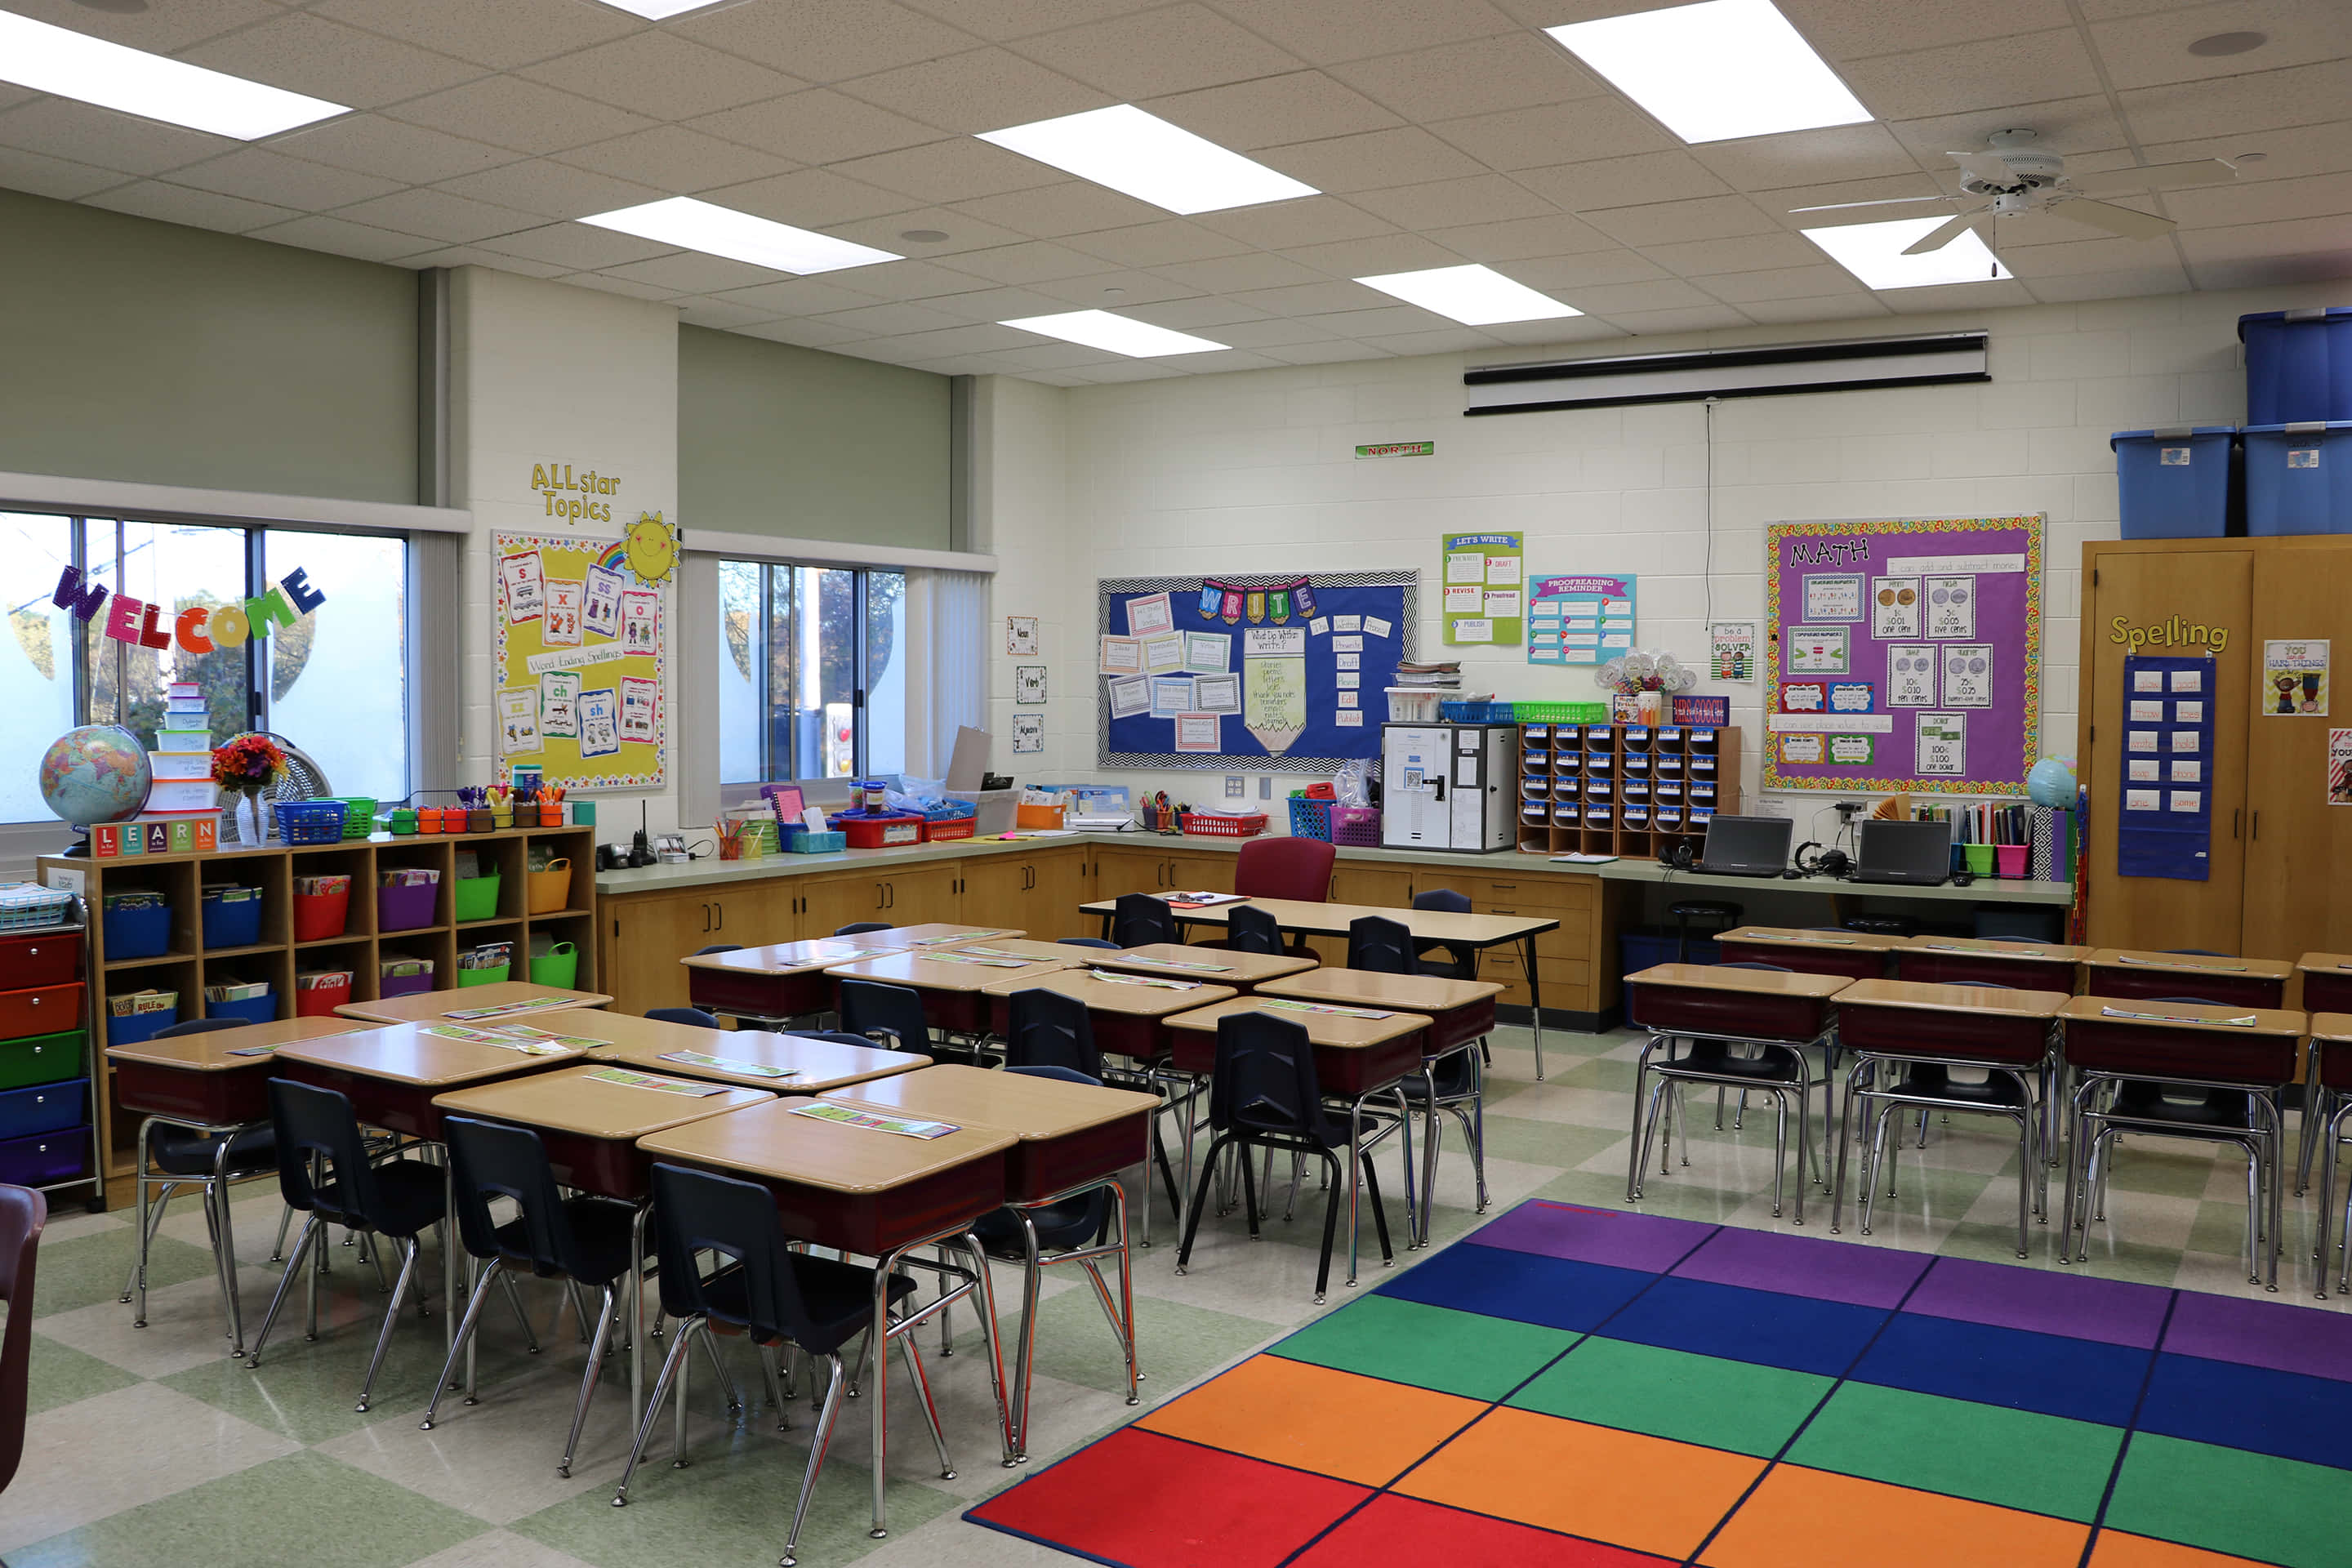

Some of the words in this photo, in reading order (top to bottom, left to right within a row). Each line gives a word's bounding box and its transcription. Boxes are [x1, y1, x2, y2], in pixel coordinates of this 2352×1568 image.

[1368, 445, 1422, 456] NORTH
[531, 463, 577, 490] ALL
[581, 470, 621, 495] star
[542, 490, 611, 525] Topics
[1790, 539, 1869, 566] MATH
[1548, 579, 1614, 587] PROOFREADING
[1202, 587, 1312, 615] WRITE
[52, 564, 326, 654] WELCOME
[1714, 635, 1751, 644] problem
[2110, 615, 2229, 653] Spelling
[1715, 644, 1751, 652] SOLVER
[1026, 677, 1039, 688] Verb
[2176, 679, 2198, 691] goat
[554, 685, 567, 697] ch
[1341, 693, 1356, 705] Edit
[590, 704, 604, 716] sh
[1695, 699, 1723, 723] GOOCH
[2136, 706, 2160, 719] throw
[2180, 706, 2200, 719] toes
[2175, 737, 2195, 749] hold
[2173, 765, 2197, 780] phone
[2174, 799, 2198, 808] some
